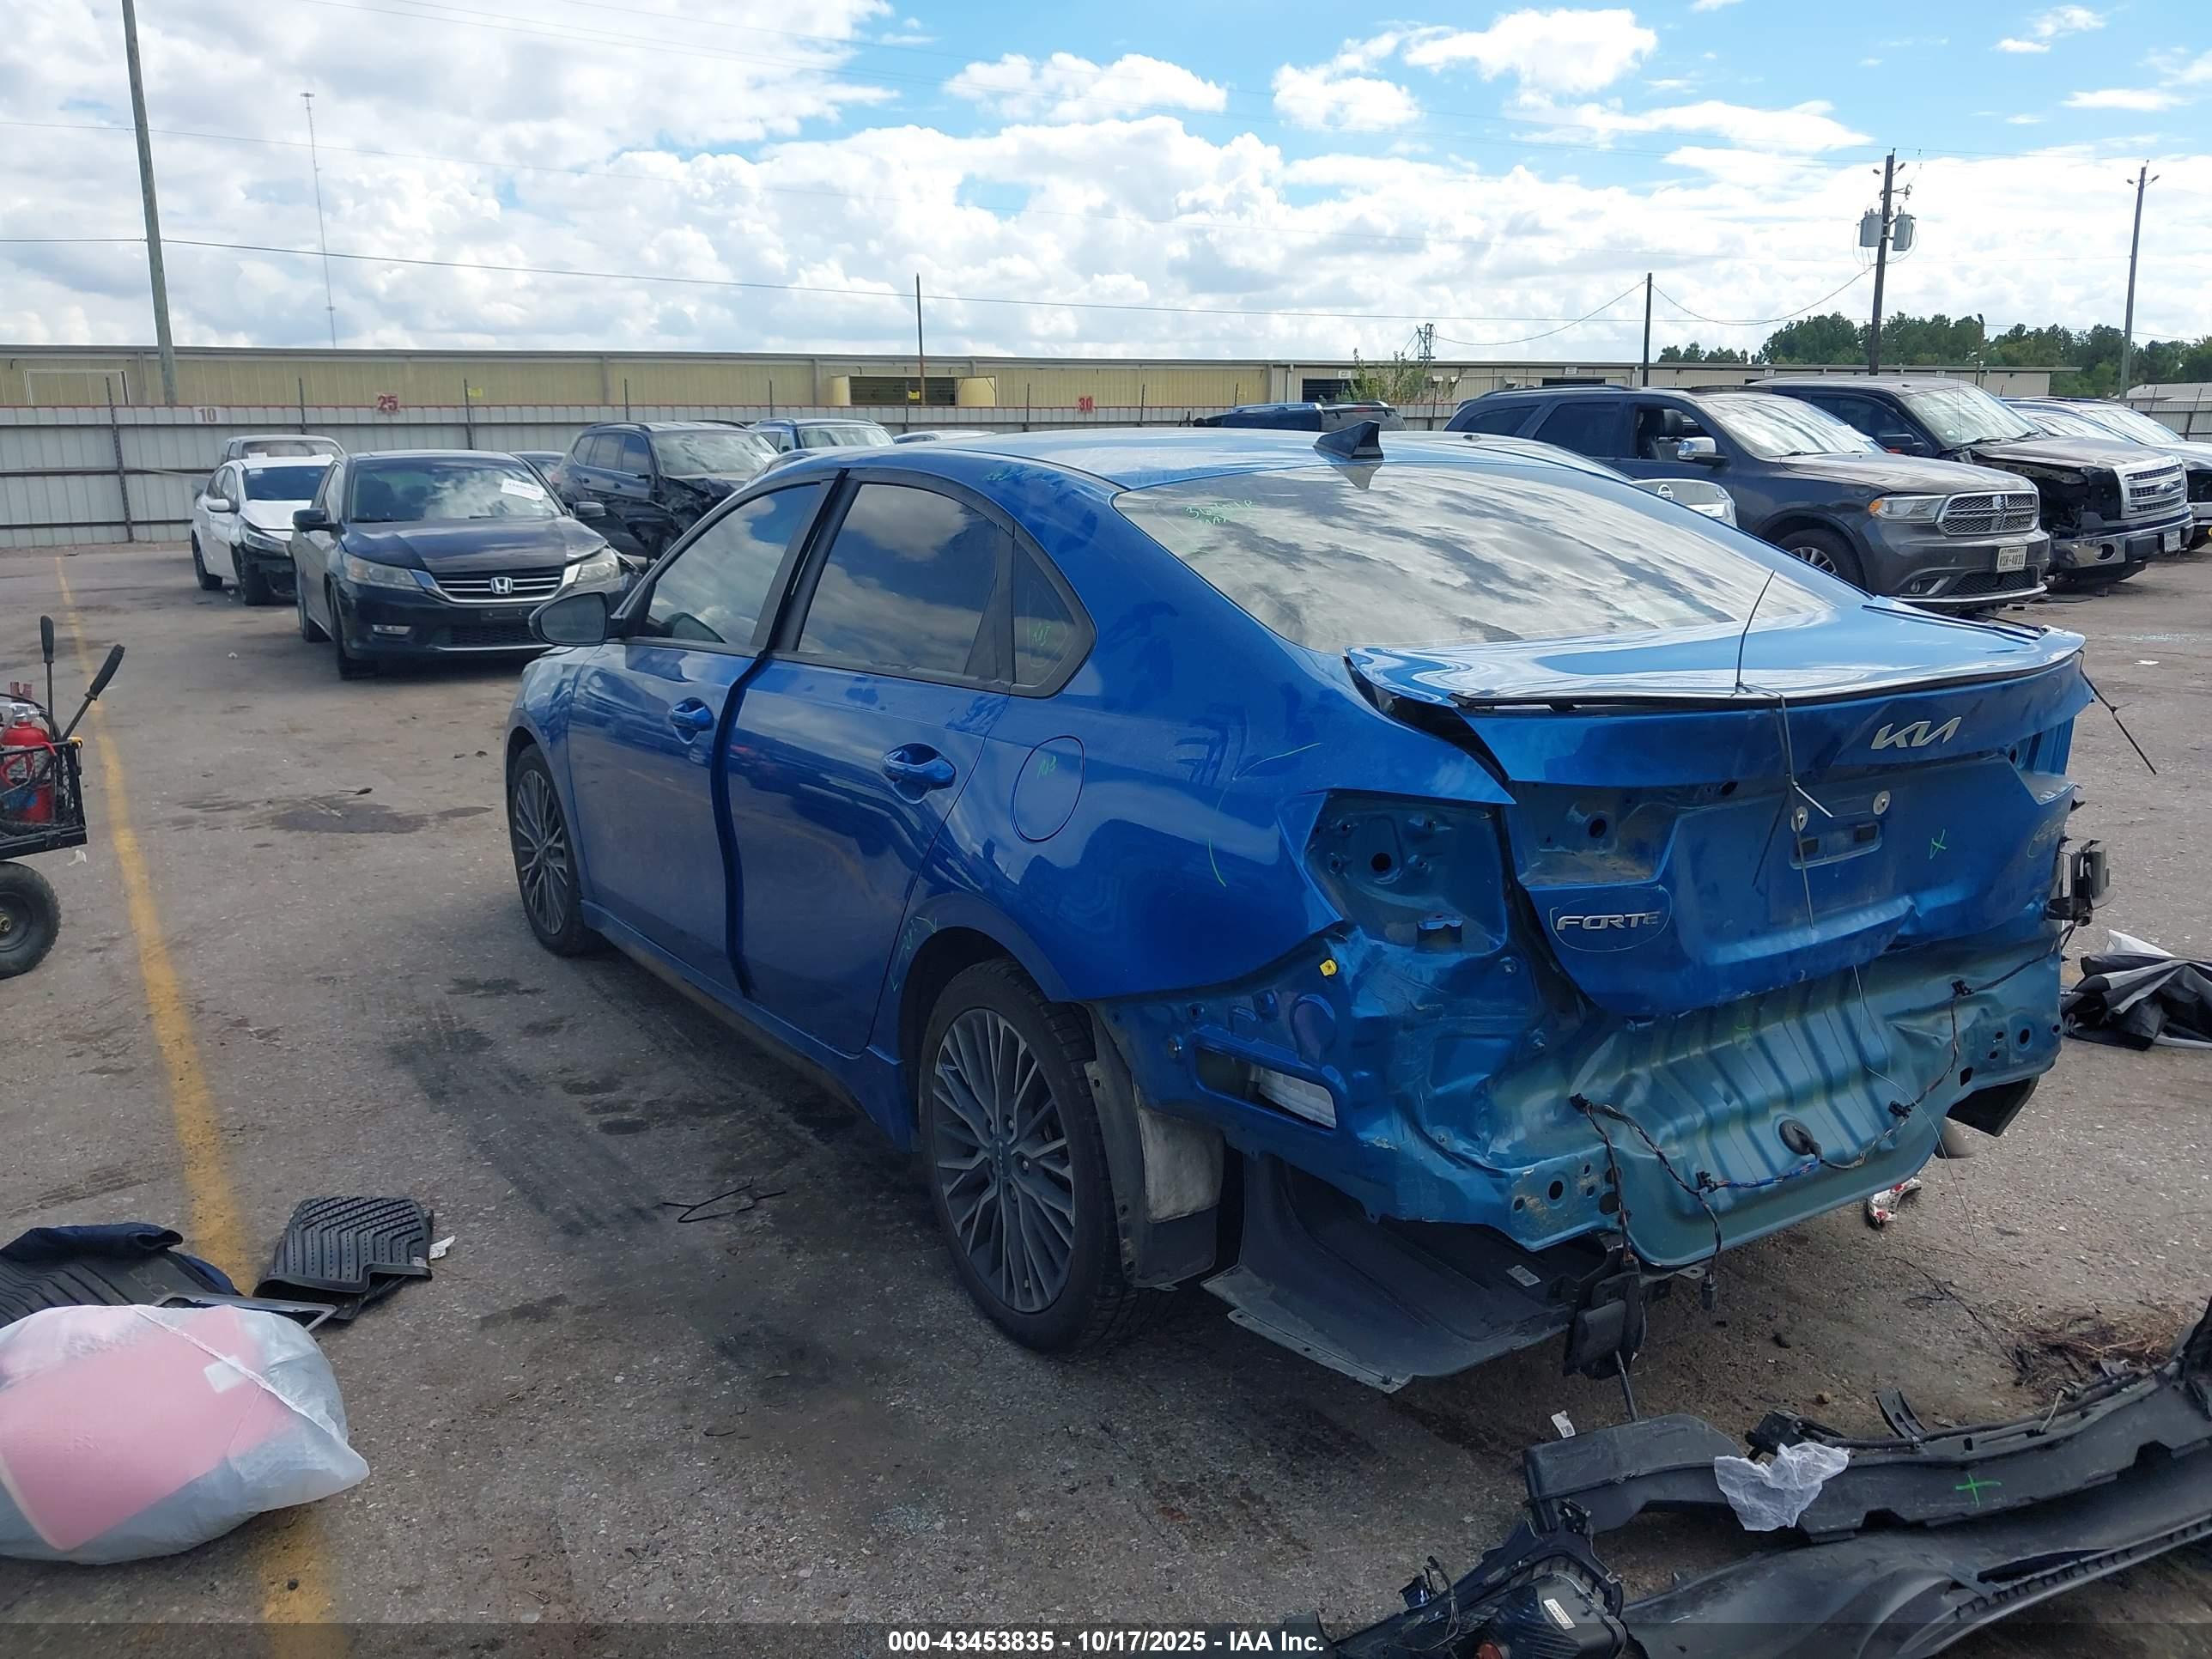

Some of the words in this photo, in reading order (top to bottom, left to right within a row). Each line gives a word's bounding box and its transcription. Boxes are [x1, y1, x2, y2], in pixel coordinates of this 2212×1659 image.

[377, 394, 398, 413] 25
[1079, 398, 1093, 412] 30
[198, 407, 217, 422] 10
[1556, 911, 1662, 930] FORTE
